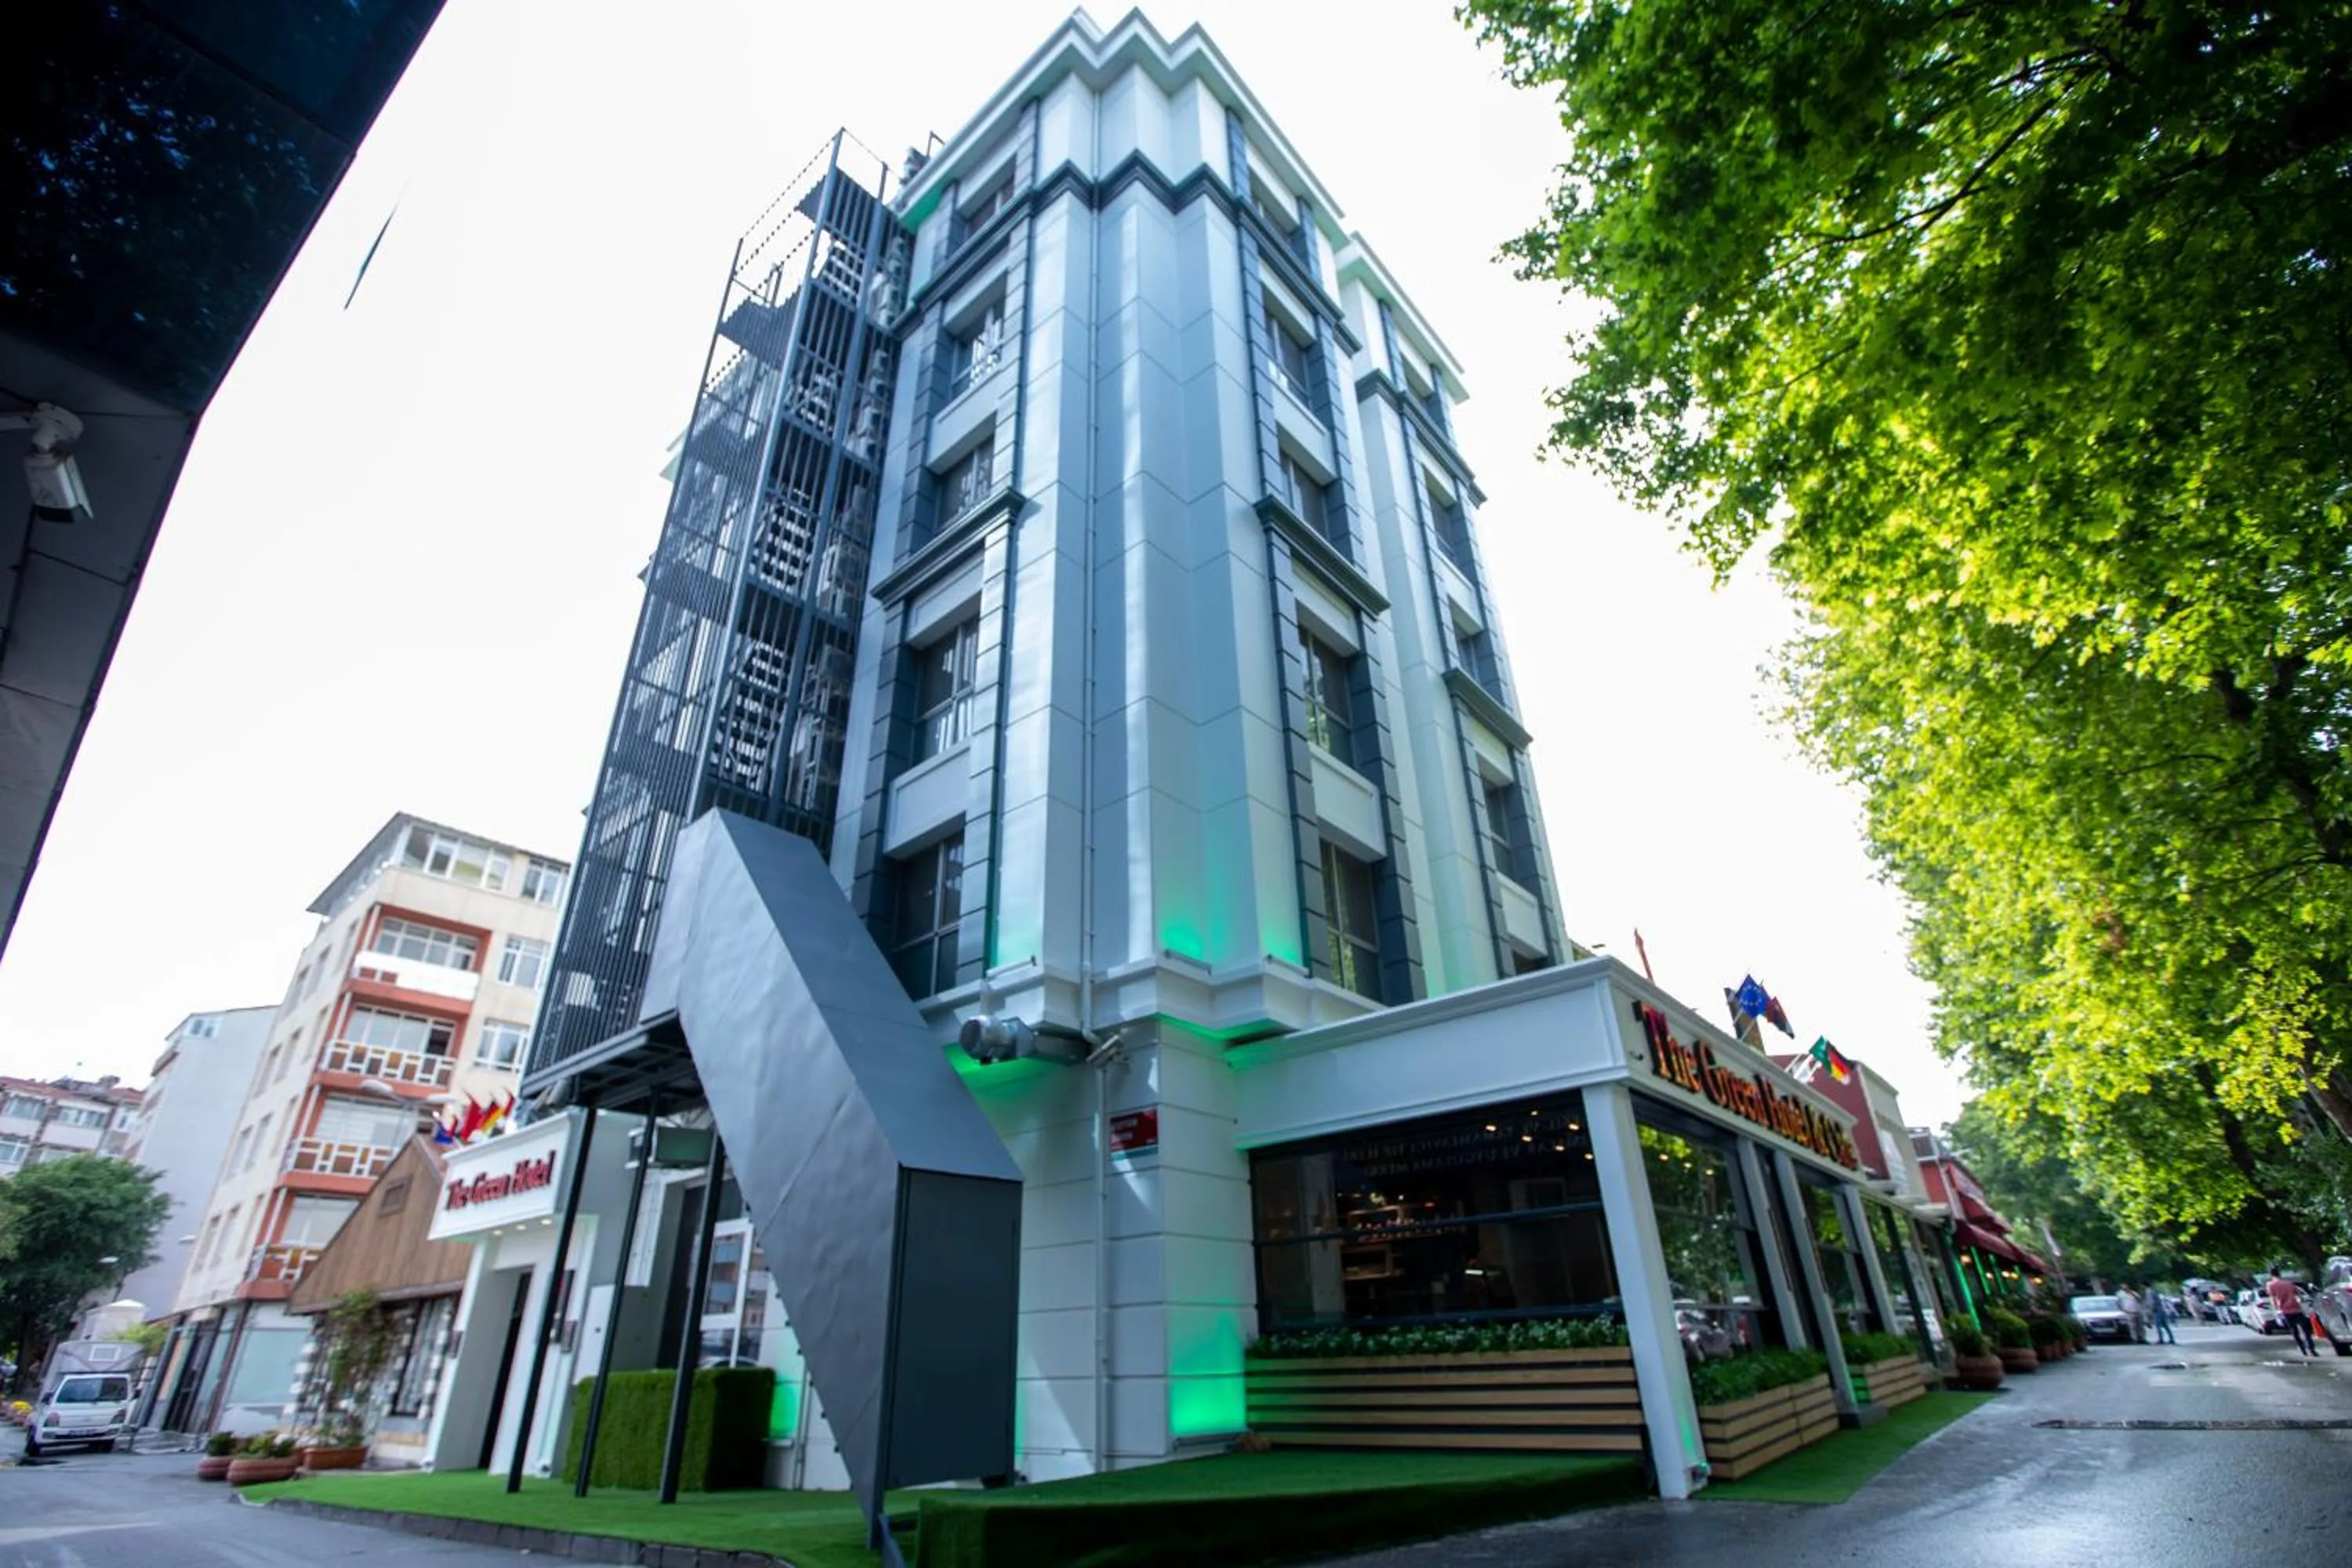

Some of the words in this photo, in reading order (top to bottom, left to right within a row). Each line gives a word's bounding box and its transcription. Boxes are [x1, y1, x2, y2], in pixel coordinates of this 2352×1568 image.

[1632, 1000, 1702, 1094] The
[471, 1171, 510, 1204] Green
[512, 1149, 557, 1193] Hotel
